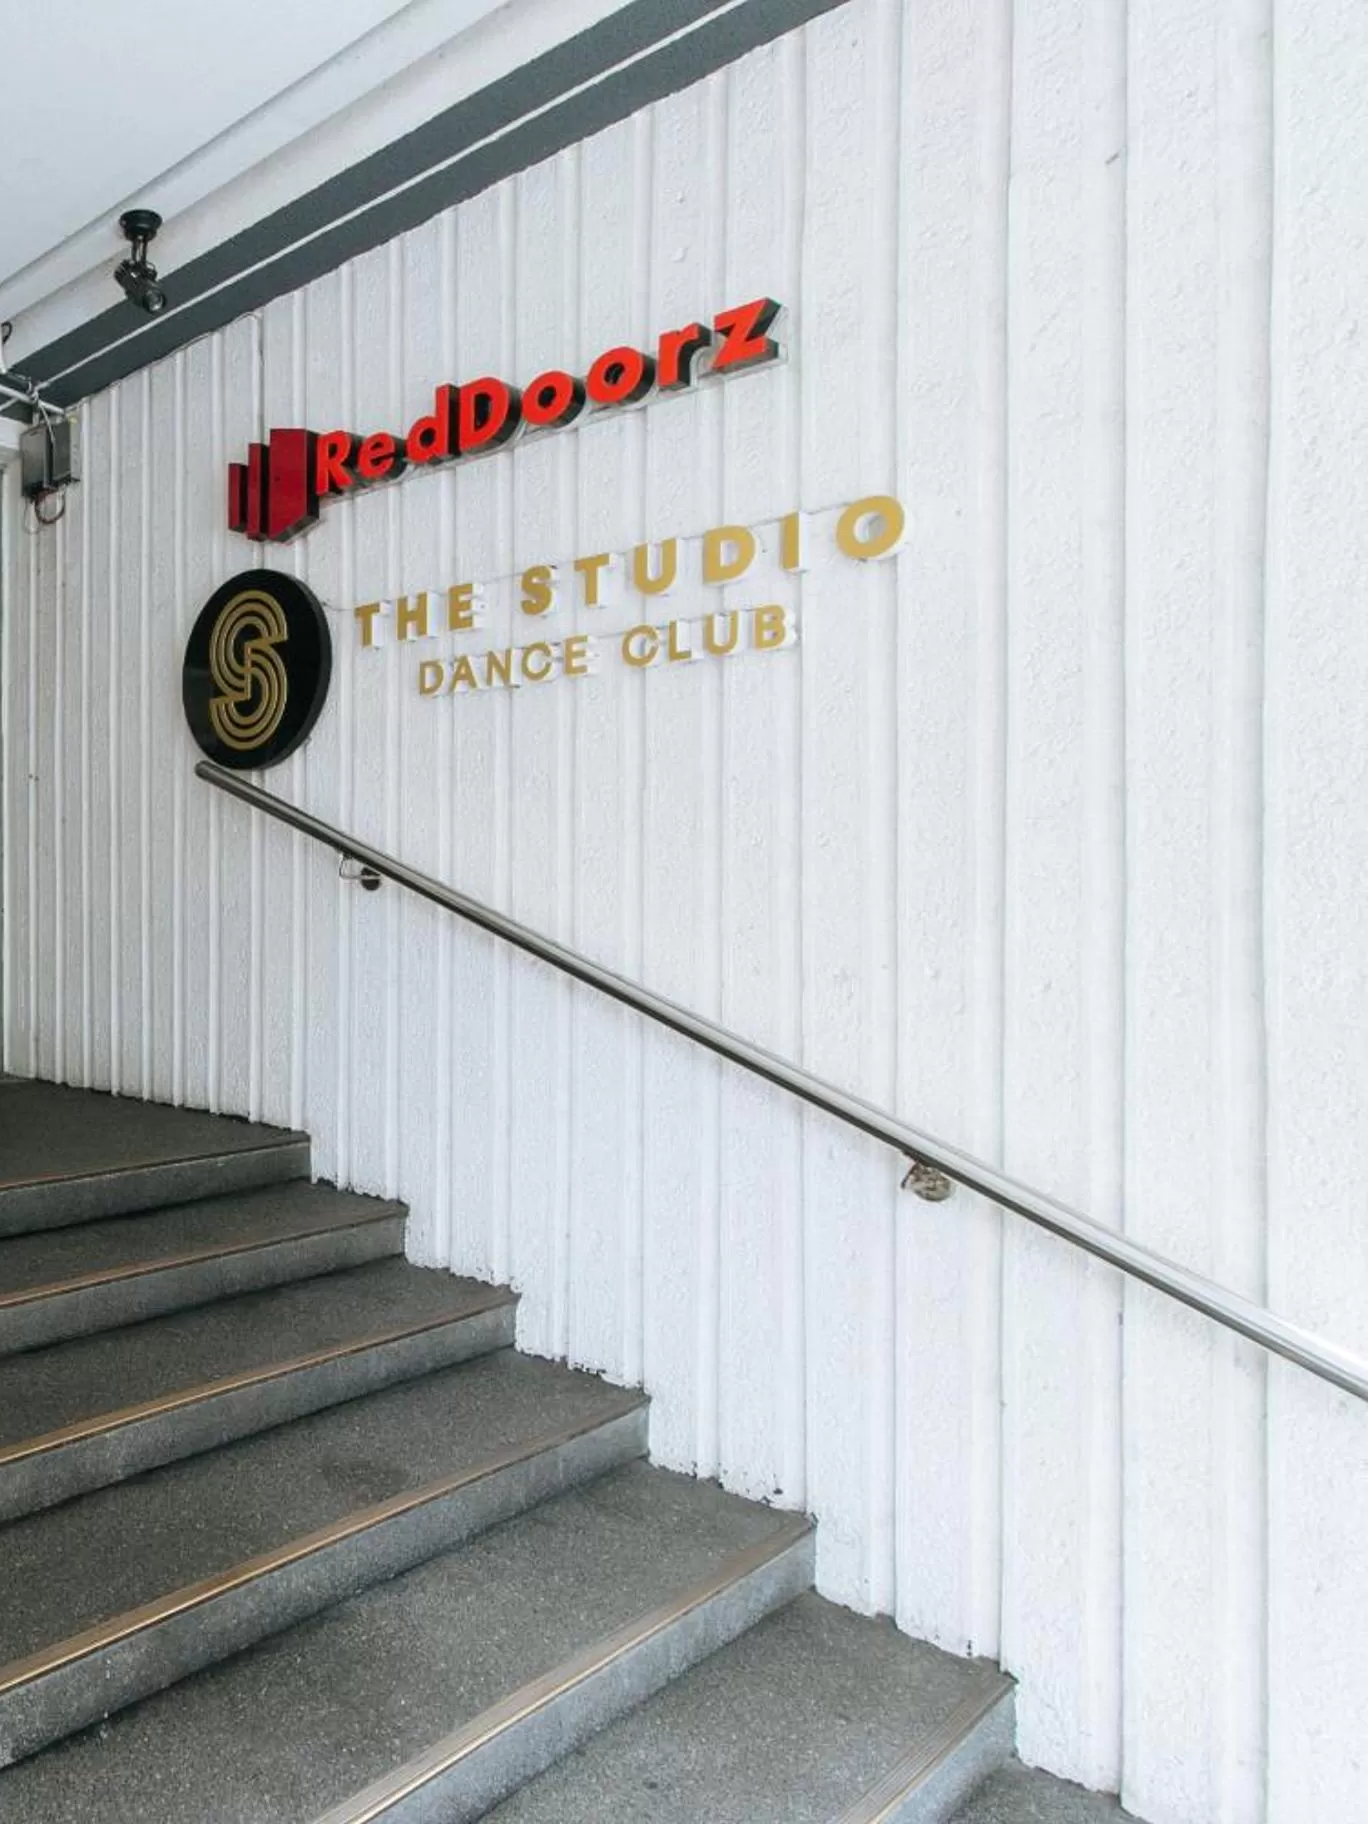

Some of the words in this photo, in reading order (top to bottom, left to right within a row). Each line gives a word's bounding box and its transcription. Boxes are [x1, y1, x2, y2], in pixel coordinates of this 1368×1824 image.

[316, 297, 778, 496] RedDoorz
[353, 582, 475, 649] THE
[520, 494, 906, 616] STUDIO
[418, 635, 589, 696] DANCE
[621, 604, 787, 668] CLUB
